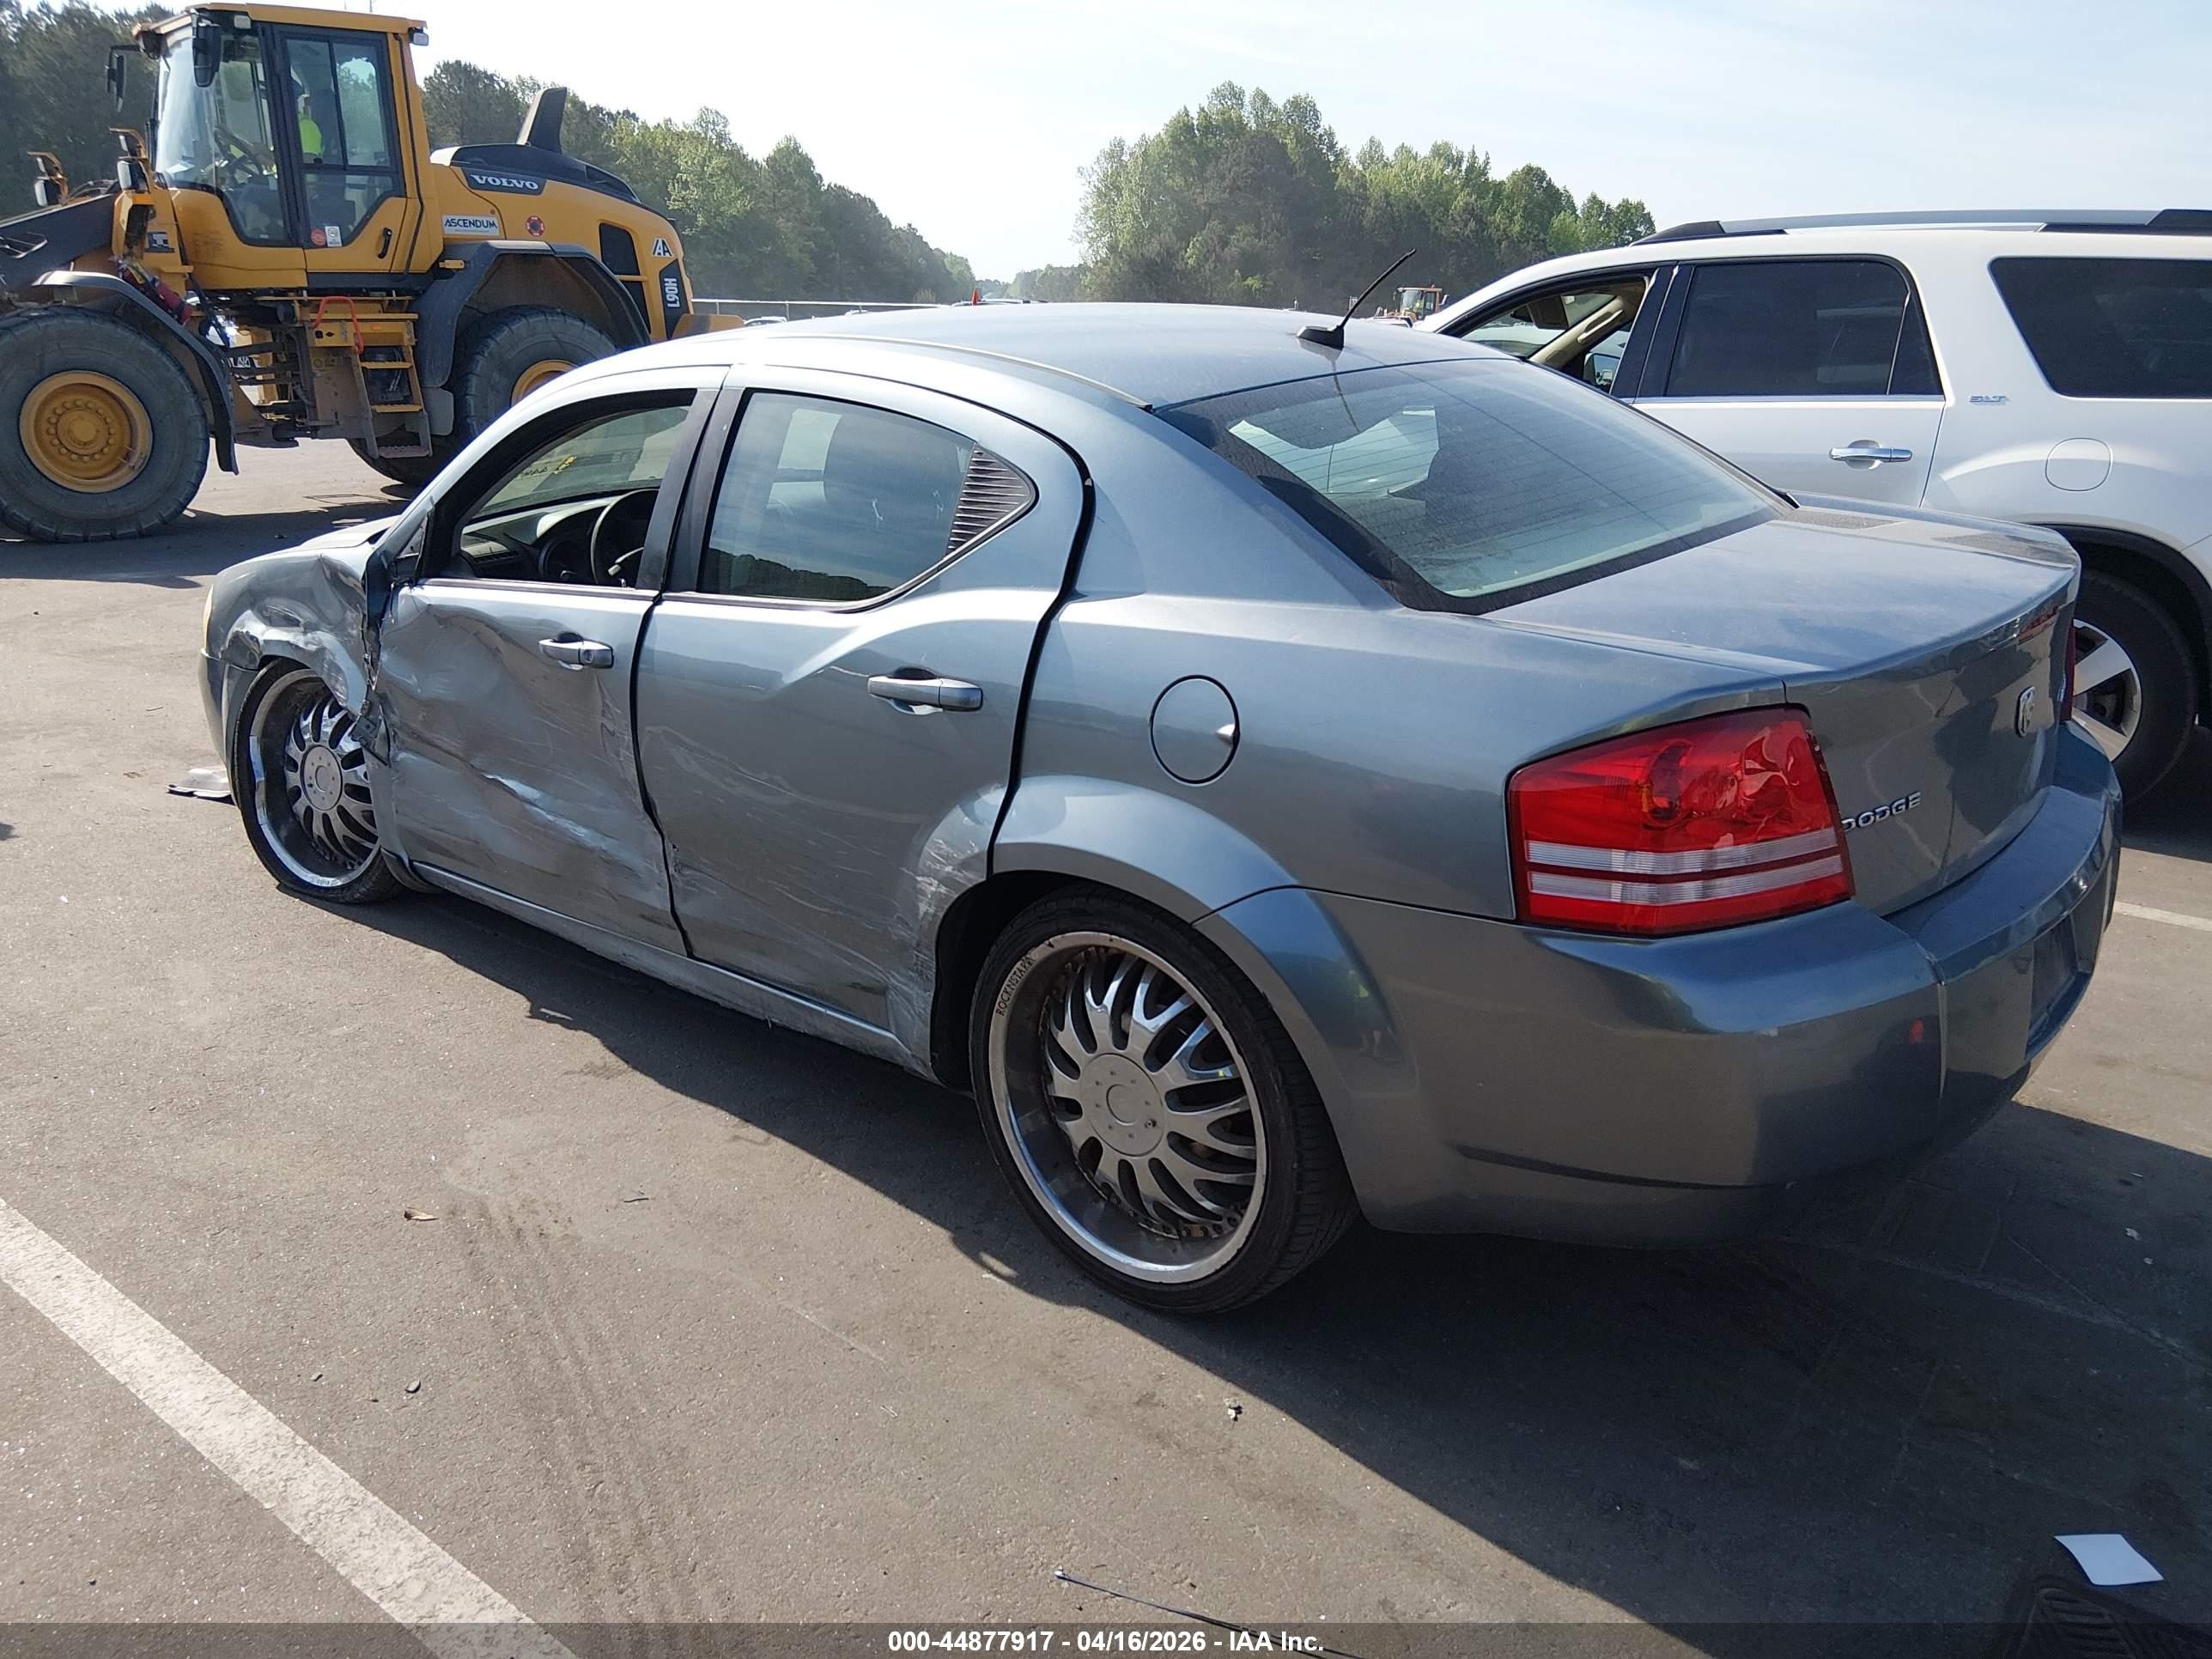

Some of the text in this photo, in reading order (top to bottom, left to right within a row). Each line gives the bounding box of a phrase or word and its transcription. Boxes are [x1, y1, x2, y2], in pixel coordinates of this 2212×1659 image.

[470, 174, 539, 190] VOLVO
[444, 218, 498, 229] ASCENDUM
[664, 277, 681, 307] L90H
[1839, 791, 1922, 833] DODGE
